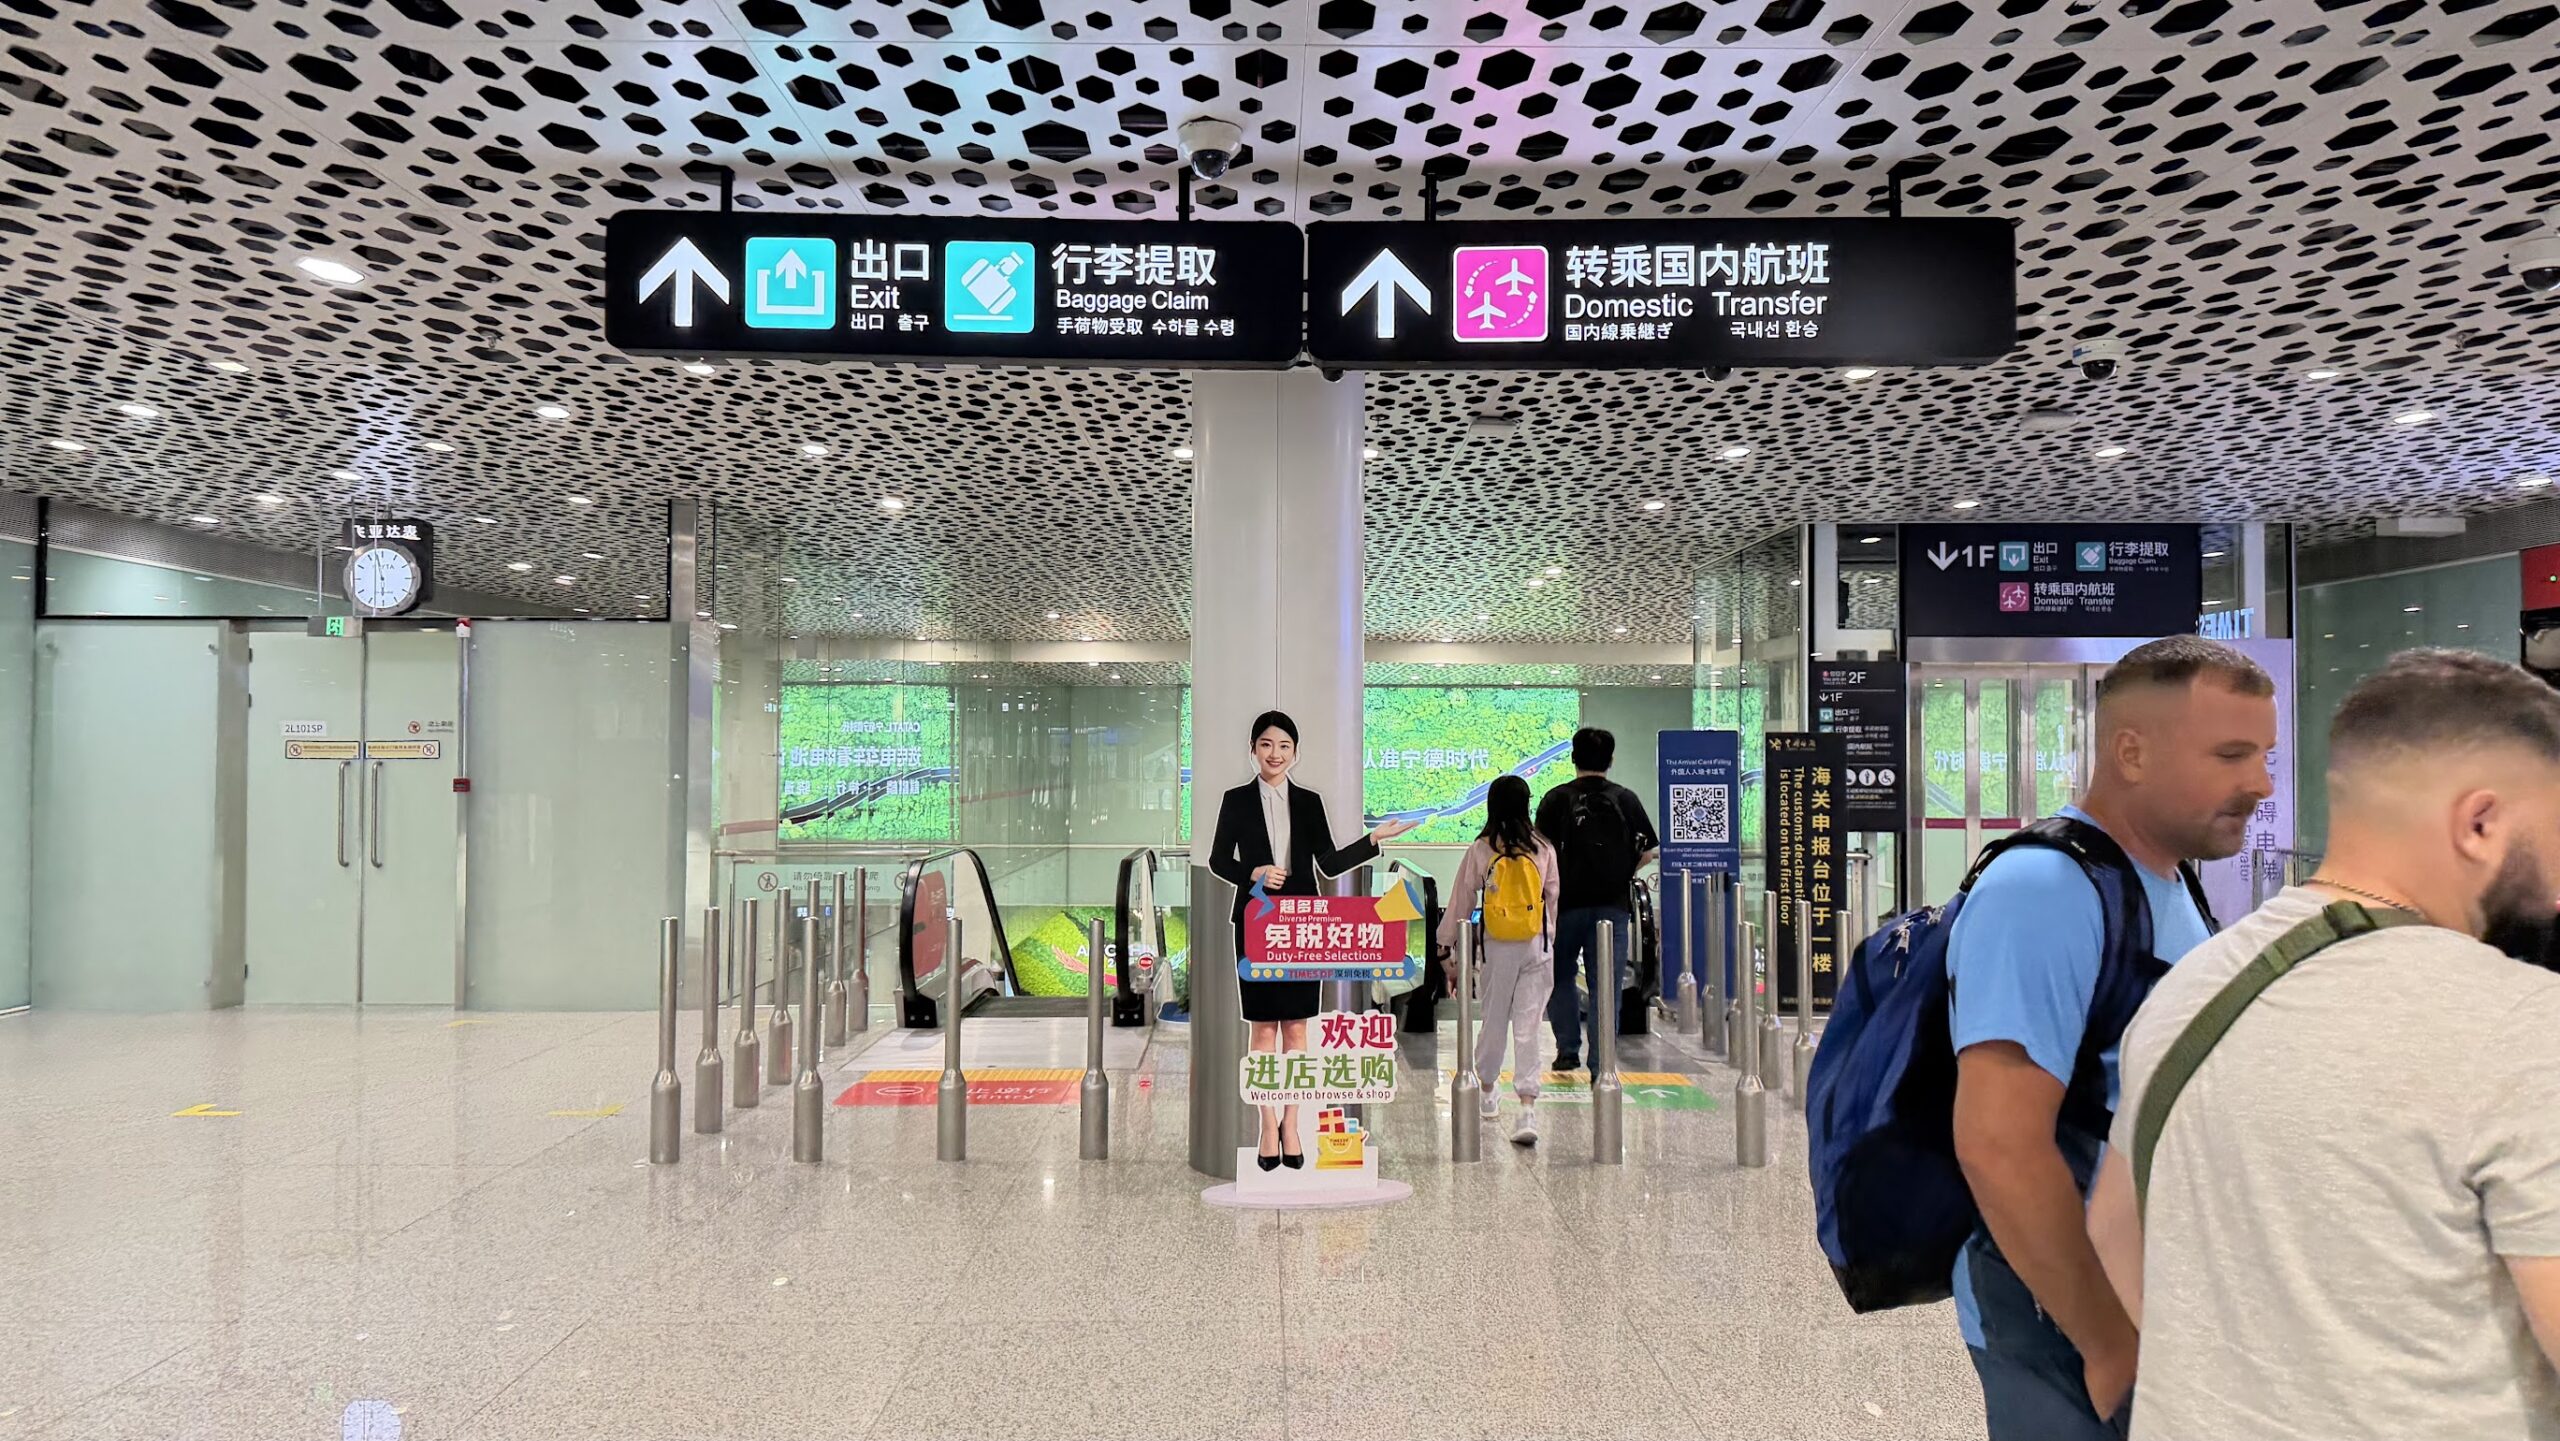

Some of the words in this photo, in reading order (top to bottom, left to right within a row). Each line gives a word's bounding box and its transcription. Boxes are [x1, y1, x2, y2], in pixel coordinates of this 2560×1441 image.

[851, 239, 930, 281] 出口
[1051, 243, 1217, 286] 行李提取
[1566, 242, 1830, 288] 转乘国内航班
[851, 284, 900, 309] Exit
[1056, 289, 1147, 313] Baggage
[1151, 291, 1209, 310] Claim
[1565, 293, 1694, 319] Domestic
[1711, 290, 1828, 316] Transfer
[850, 313, 884, 331] 出口
[897, 313, 930, 332] 출구
[1056, 317, 1143, 335] 手荷物受取
[1152, 318, 1200, 336] 수하물
[1204, 318, 1235, 336] 수령
[1730, 320, 1780, 339] 국내선
[1785, 320, 1819, 339] 환승
[1565, 322, 1674, 342] 国内線乗継ぎ
[354, 524, 418, 538] 飞亚达表
[1962, 545, 1995, 568] 1F
[2033, 542, 2058, 554] 出口
[2108, 541, 2169, 557] 行李提取
[2033, 556, 2049, 564] Exit
[2108, 558, 2137, 566] Baggage
[2033, 582, 2116, 596] 转乘国内航班
[2033, 597, 2074, 605] Domestic
[2079, 597, 2114, 605] Transfer
[1848, 671, 1867, 684] 2F
[1830, 693, 1843, 702] 1F
[1780, 769, 1791, 779] is
[1794, 766, 1805, 788] The
[1780, 780, 1791, 826] located
[1794, 790, 1803, 842] customs
[1780, 828, 1788, 843] on
[1780, 845, 1791, 865] the
[1794, 843, 1805, 912] declarati
[1812, 767, 1832, 973] 海关申报台位于一楼
[1780, 867, 1792, 893] first
[1279, 899, 1329, 914] 超多款
[1780, 895, 1792, 925] floor
[1279, 915, 1306, 923] Diverse
[1308, 915, 1342, 923] Premium
[1265, 922, 1385, 949] 免税好物
[1267, 951, 1322, 963] Duty-Free
[1325, 951, 1382, 961] Selections
[1321, 1014, 1394, 1050] 欢迎
[1245, 1053, 1394, 1090] 进店选购
[1251, 1090, 1299, 1101] Welcome
[1302, 1090, 1312, 1100] to
[1315, 1090, 1354, 1100] browse
[1356, 1089, 1364, 1099] &
[1366, 1089, 1391, 1100] shop
